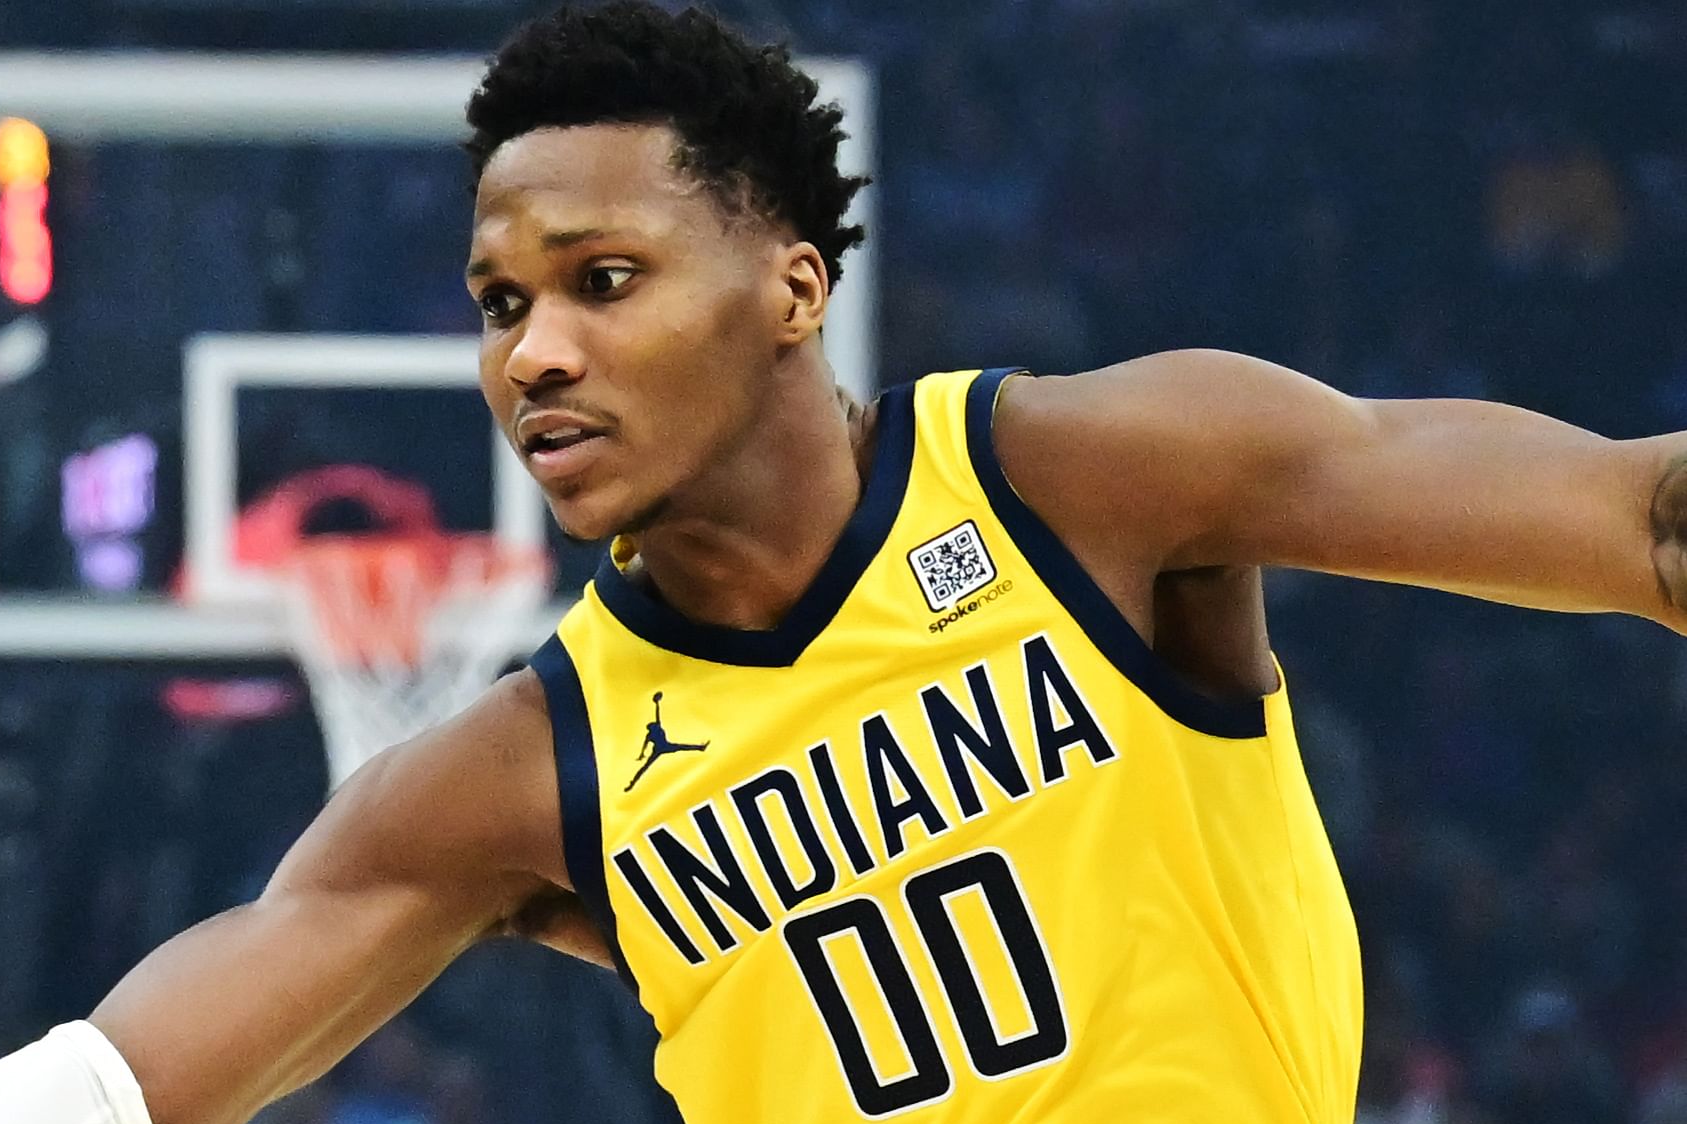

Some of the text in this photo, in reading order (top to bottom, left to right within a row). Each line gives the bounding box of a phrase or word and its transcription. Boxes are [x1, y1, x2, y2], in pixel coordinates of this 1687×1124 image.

[929, 579, 1013, 633] spokenote
[612, 632, 1120, 966] INDIANA
[777, 846, 1072, 1122] 00
